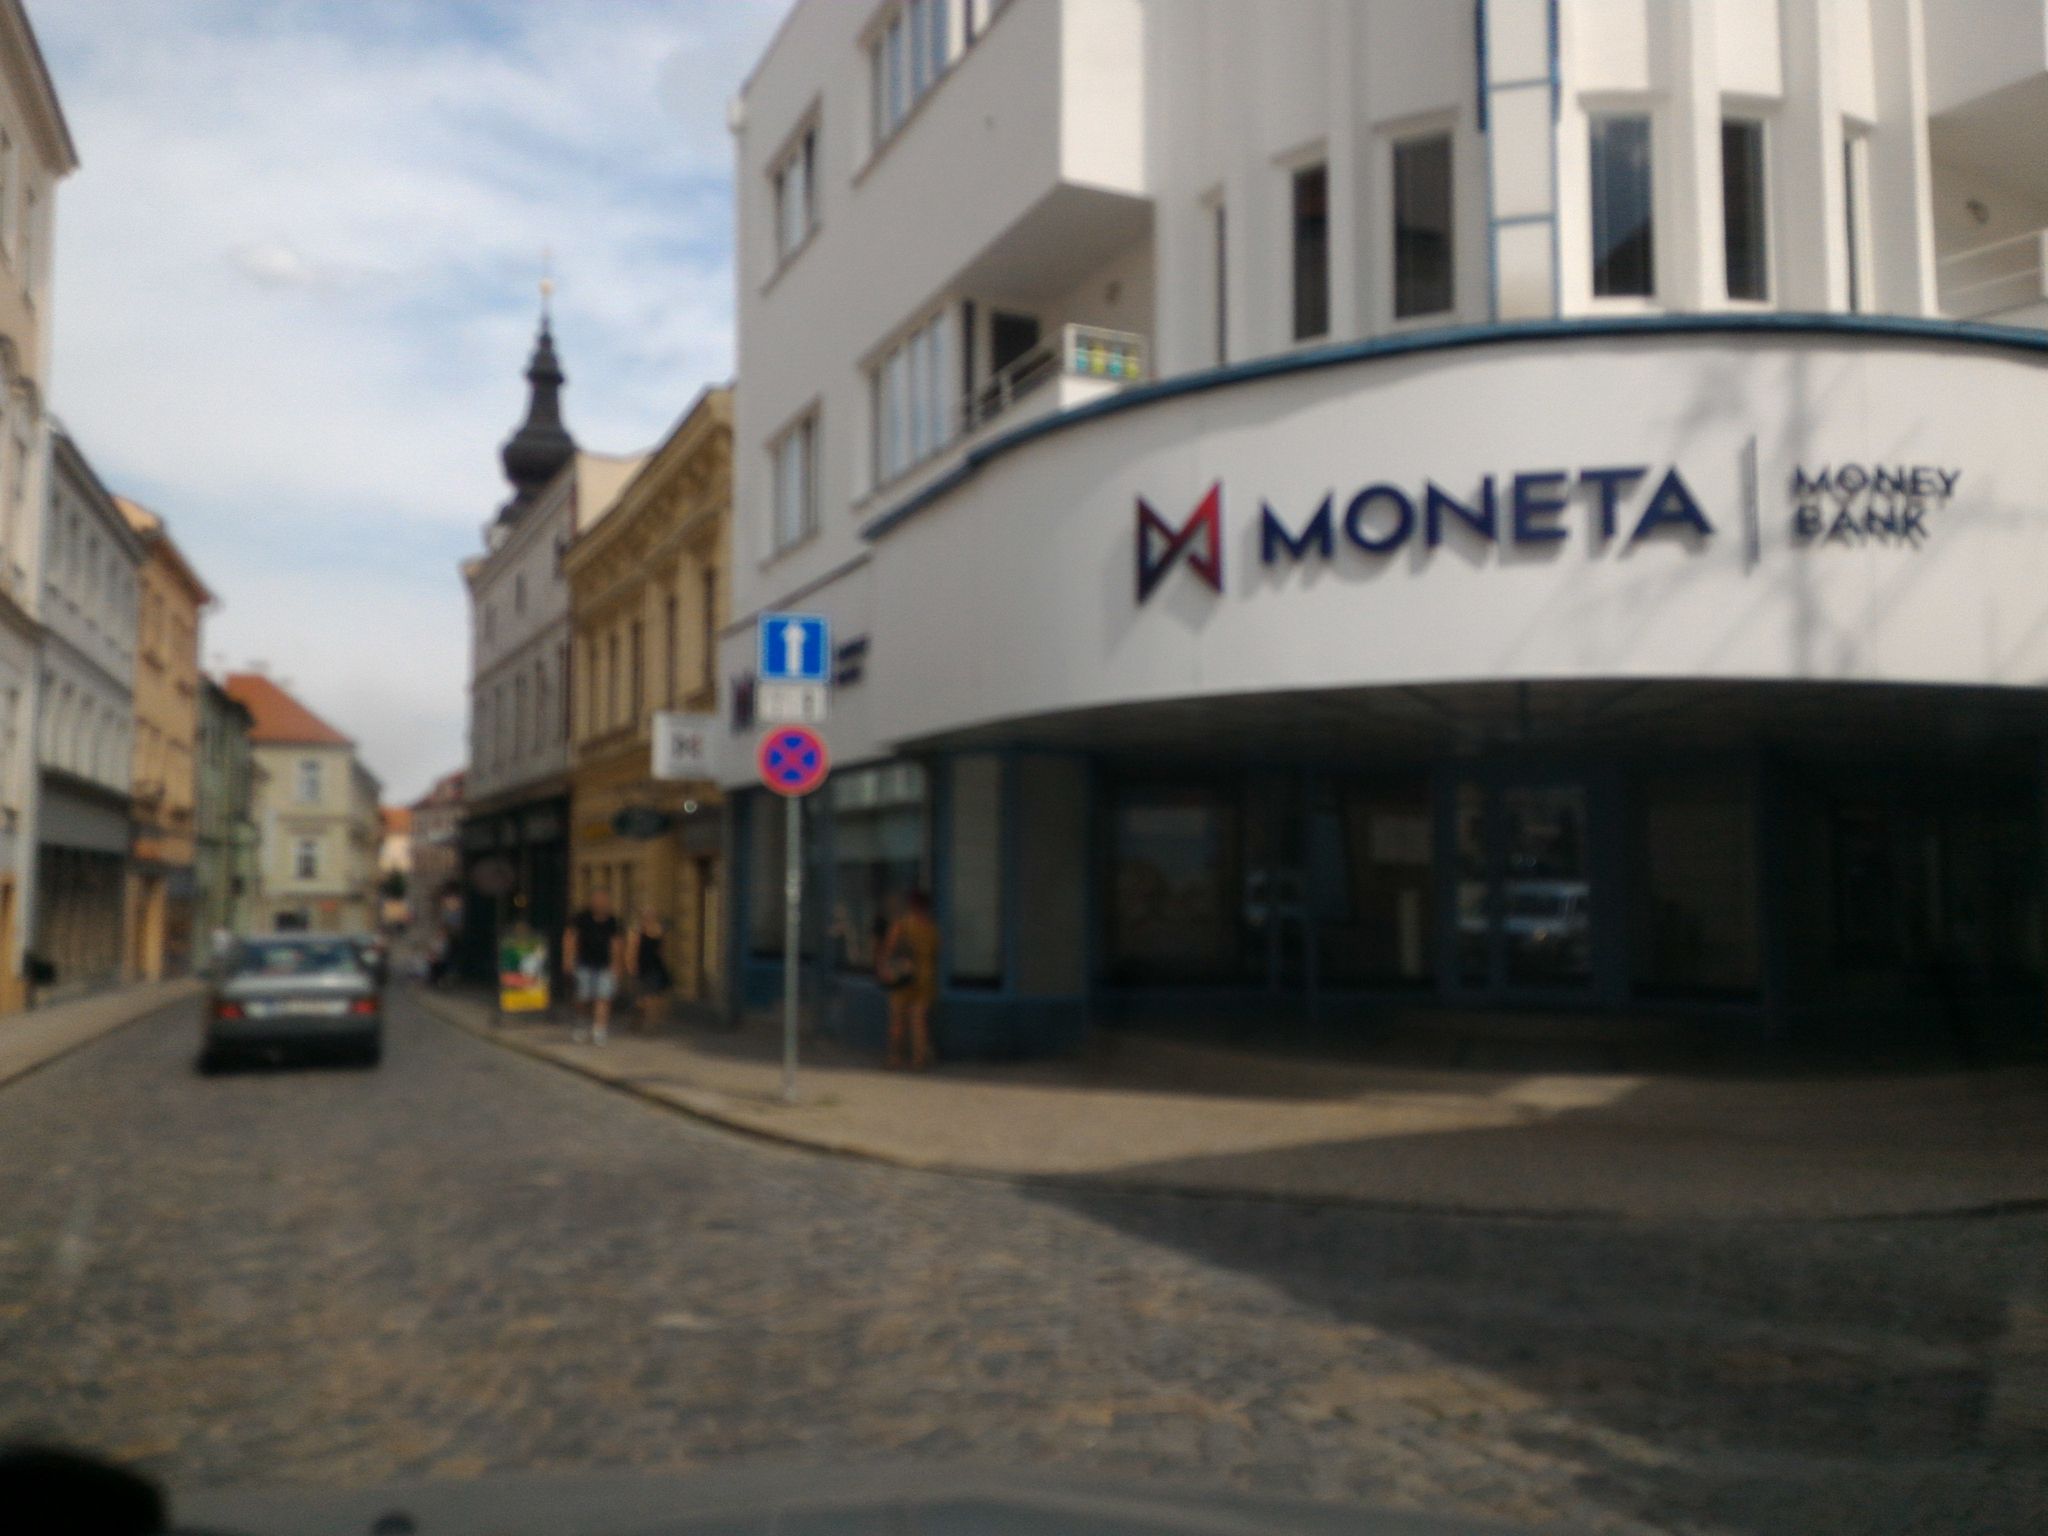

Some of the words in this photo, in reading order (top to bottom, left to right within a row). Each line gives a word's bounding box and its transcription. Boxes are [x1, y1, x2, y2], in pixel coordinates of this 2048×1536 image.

[1793, 464, 1961, 497] MONEY
[1259, 463, 1714, 566] MONETA
[1794, 502, 1928, 538] BANK
